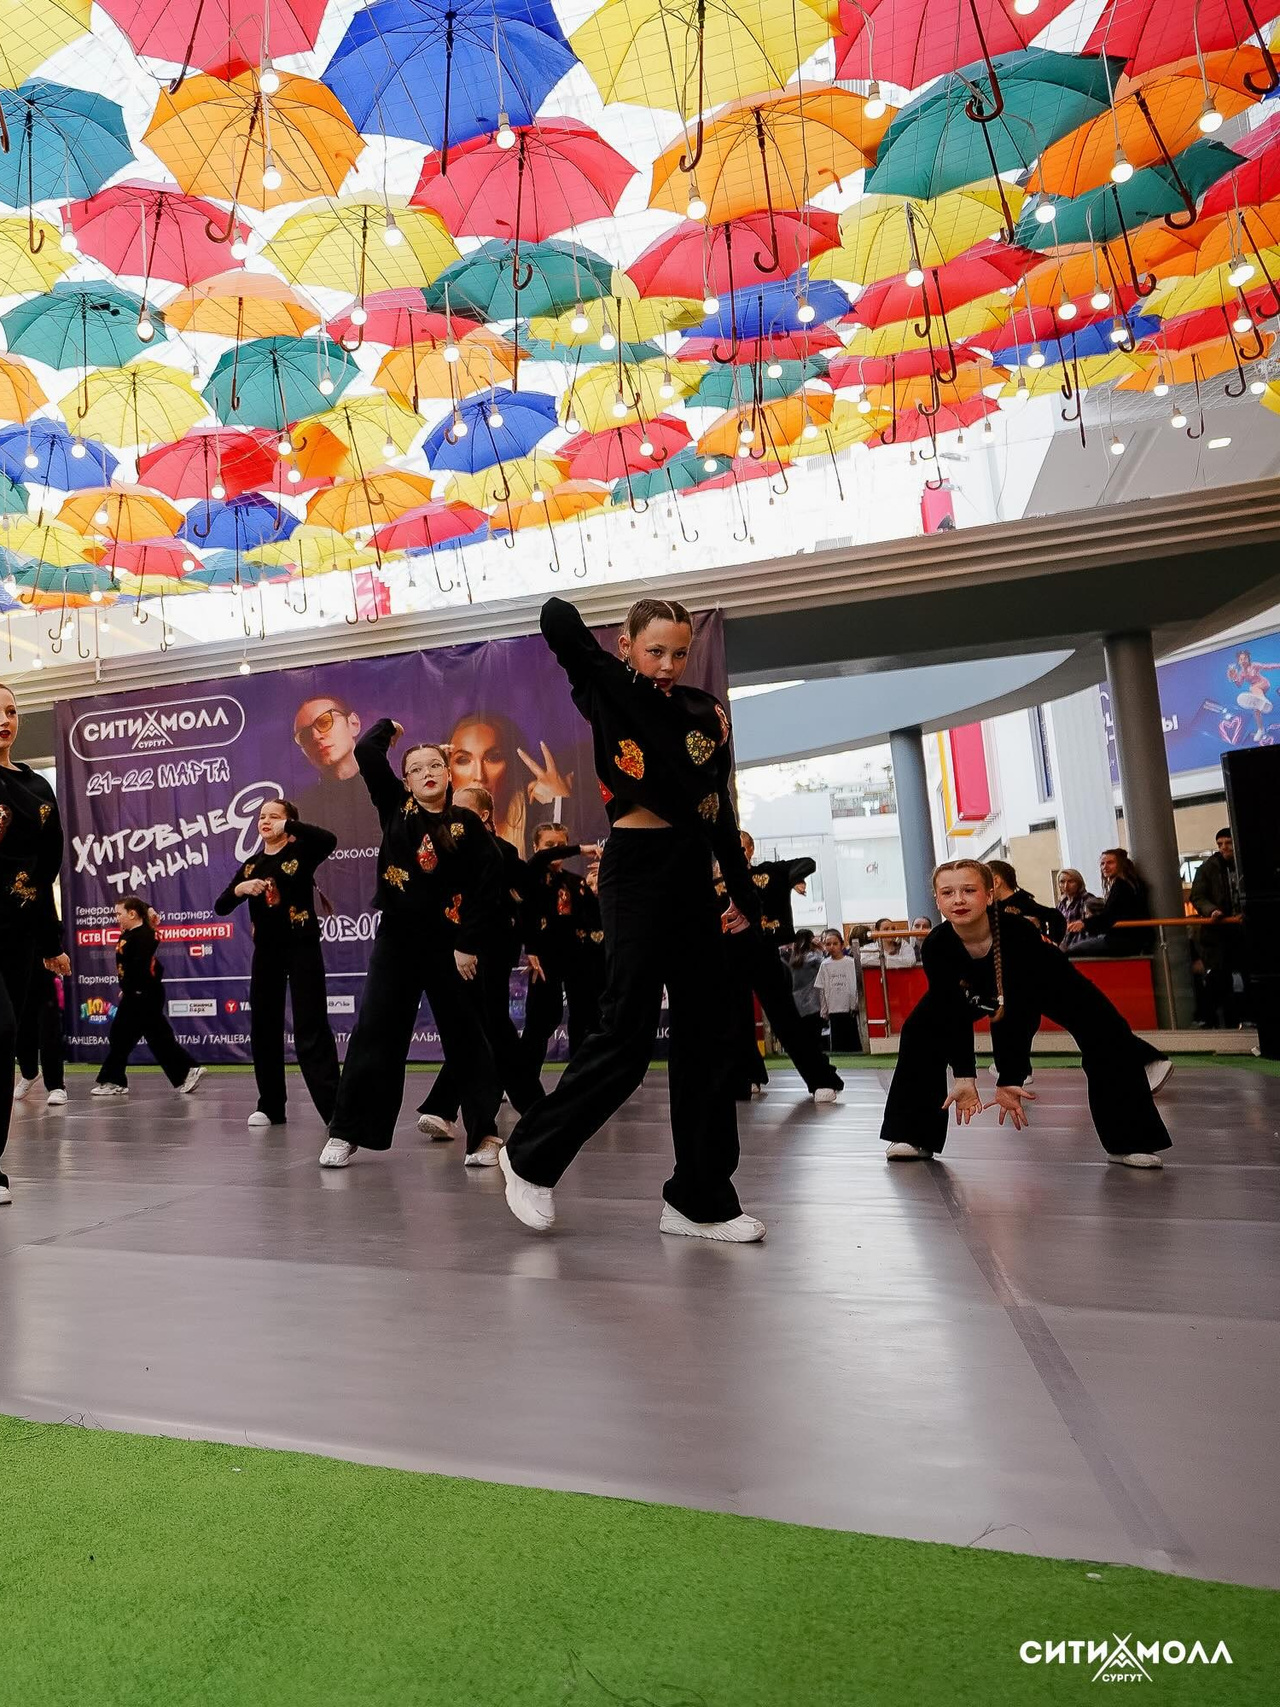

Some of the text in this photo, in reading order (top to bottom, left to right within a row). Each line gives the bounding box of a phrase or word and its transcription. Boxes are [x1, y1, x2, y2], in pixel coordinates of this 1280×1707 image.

[138, 738, 167, 749] СУРГУТ
[86, 756, 231, 797] 21-22 МАРТА
[71, 808, 230, 877] ХИТОВЫЕ
[106, 842, 209, 894] ТАНЦЫ
[76, 906, 117, 917] Генерал
[68, 1035, 110, 1046] ТАНЦЕВАЛ
[209, 1034, 252, 1045] ТАНЦЕВА
